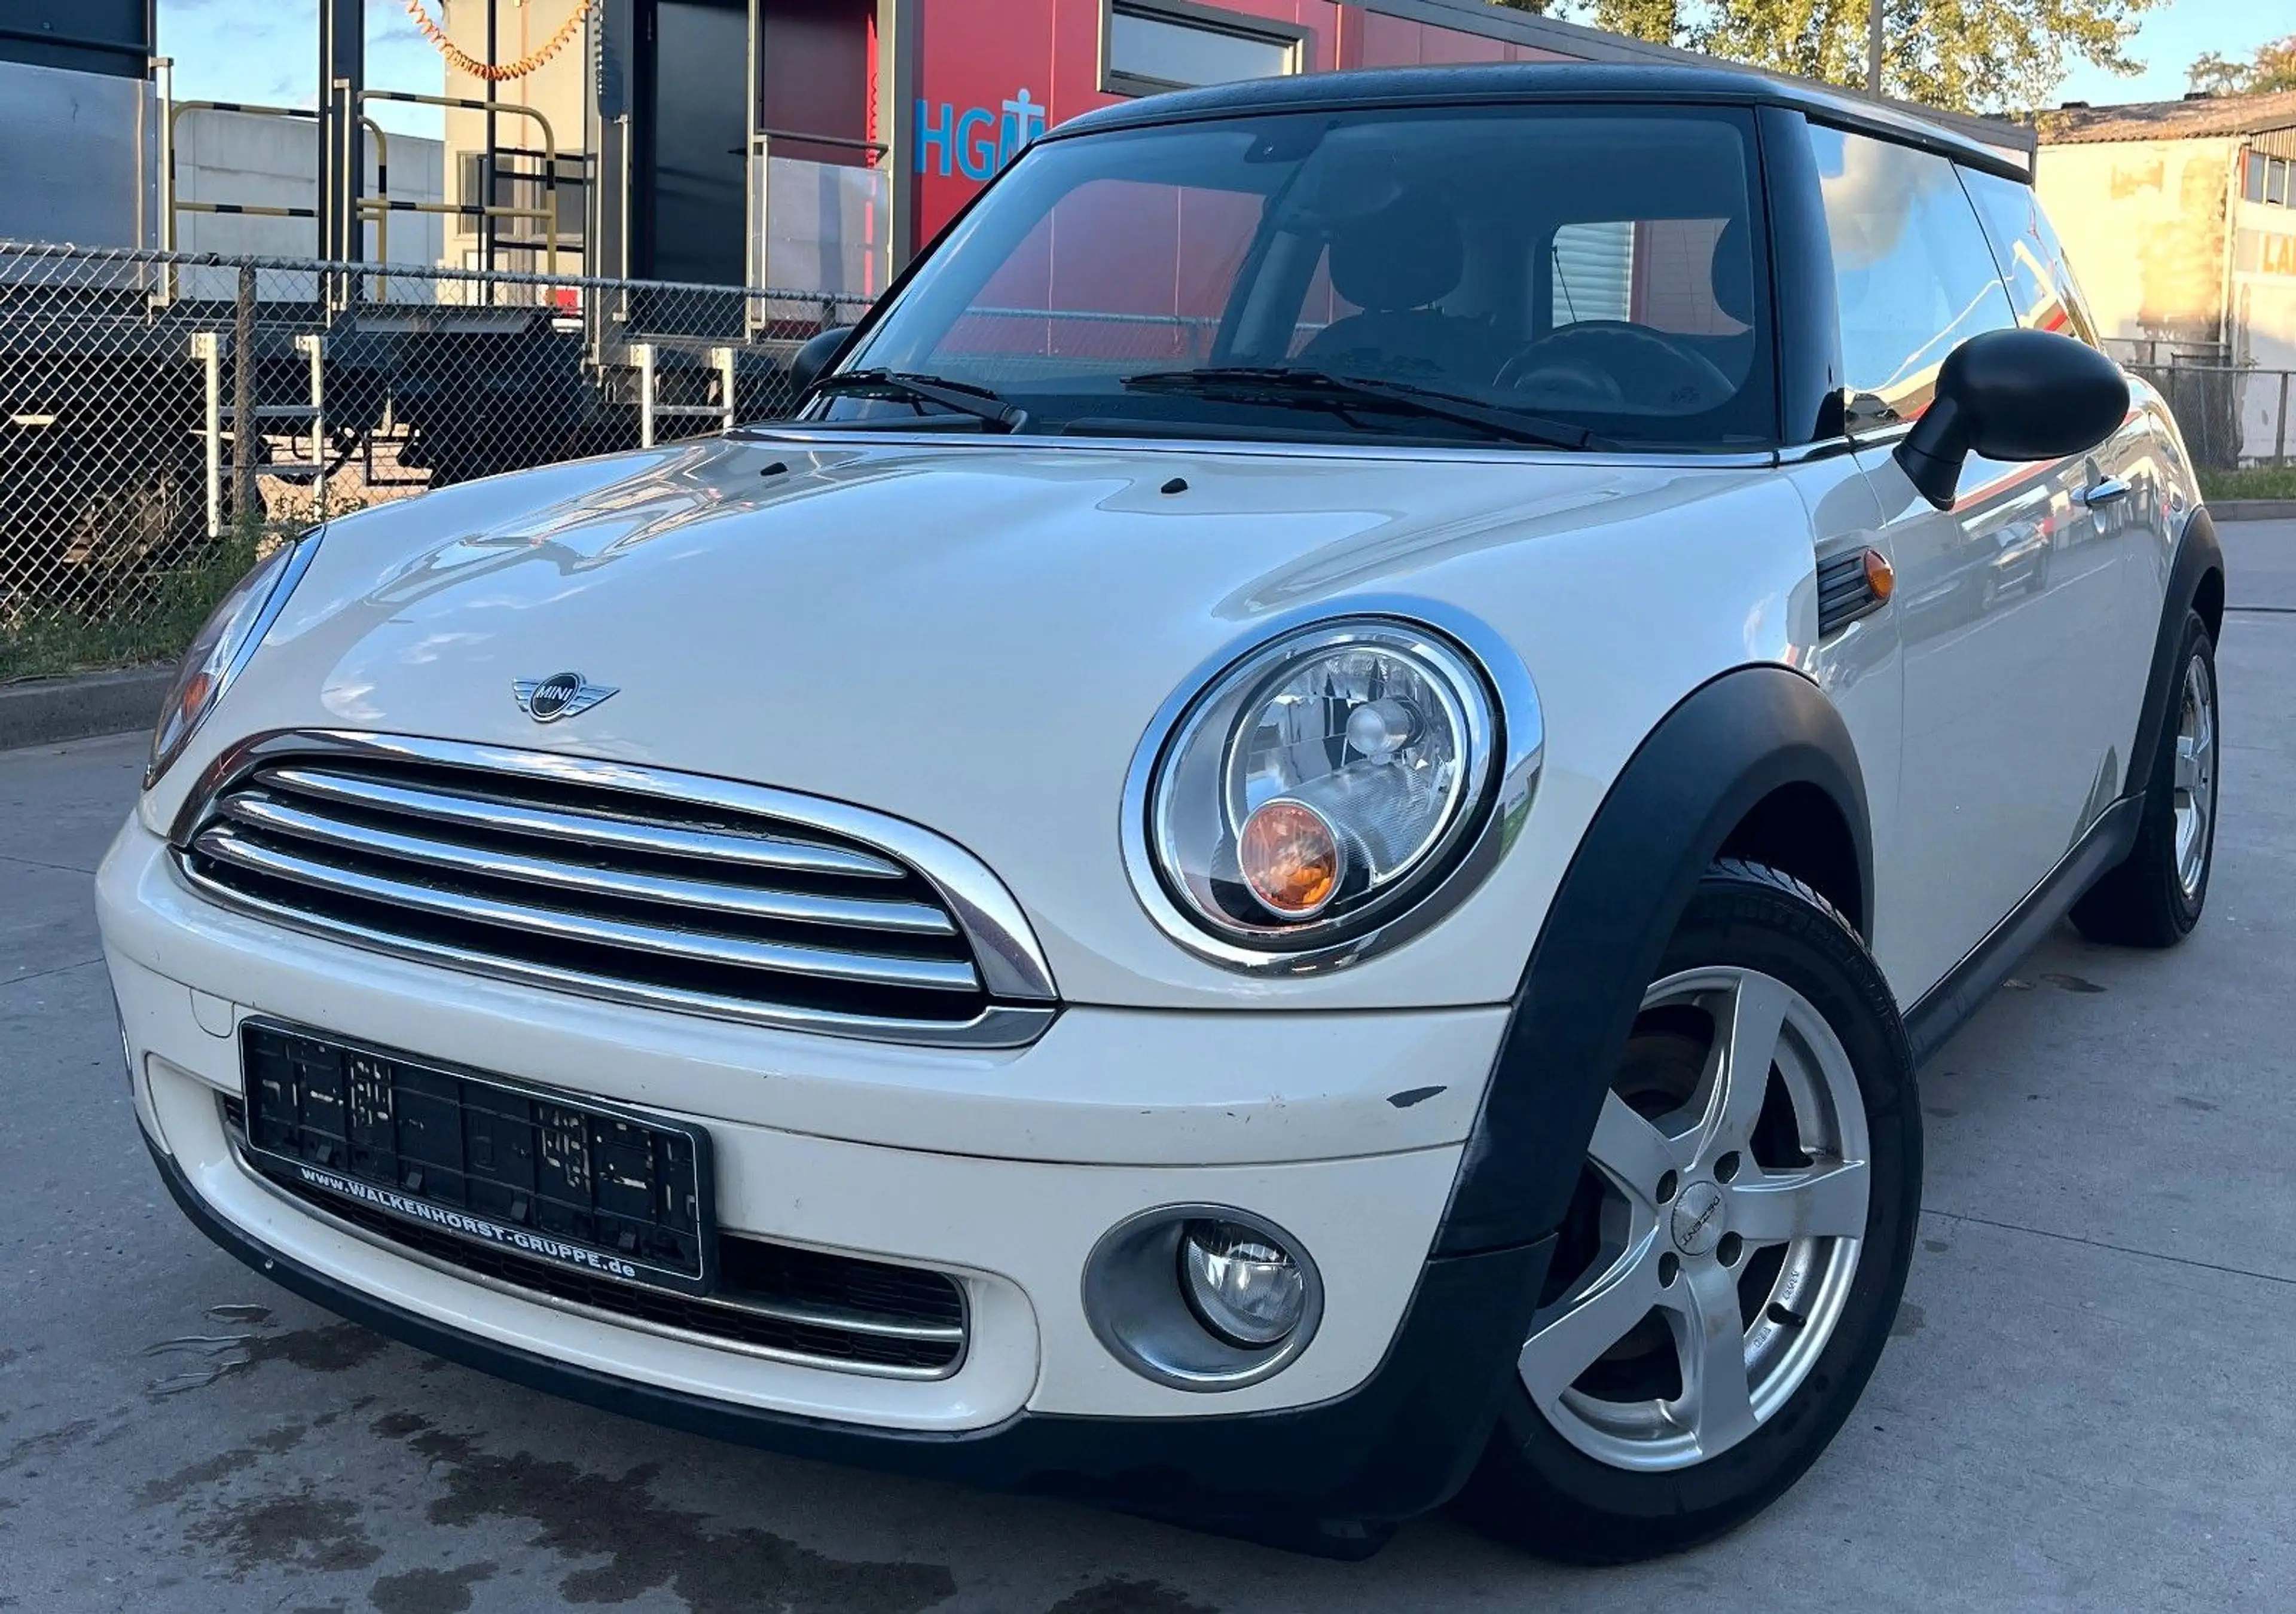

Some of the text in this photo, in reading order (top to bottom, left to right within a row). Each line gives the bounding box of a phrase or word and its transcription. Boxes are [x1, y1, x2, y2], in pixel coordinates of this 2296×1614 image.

[2262, 231, 2296, 276] LA
[536, 686, 573, 701] MINI
[301, 1166, 636, 1277] www.WALKENHORST-GRUPPE.de
